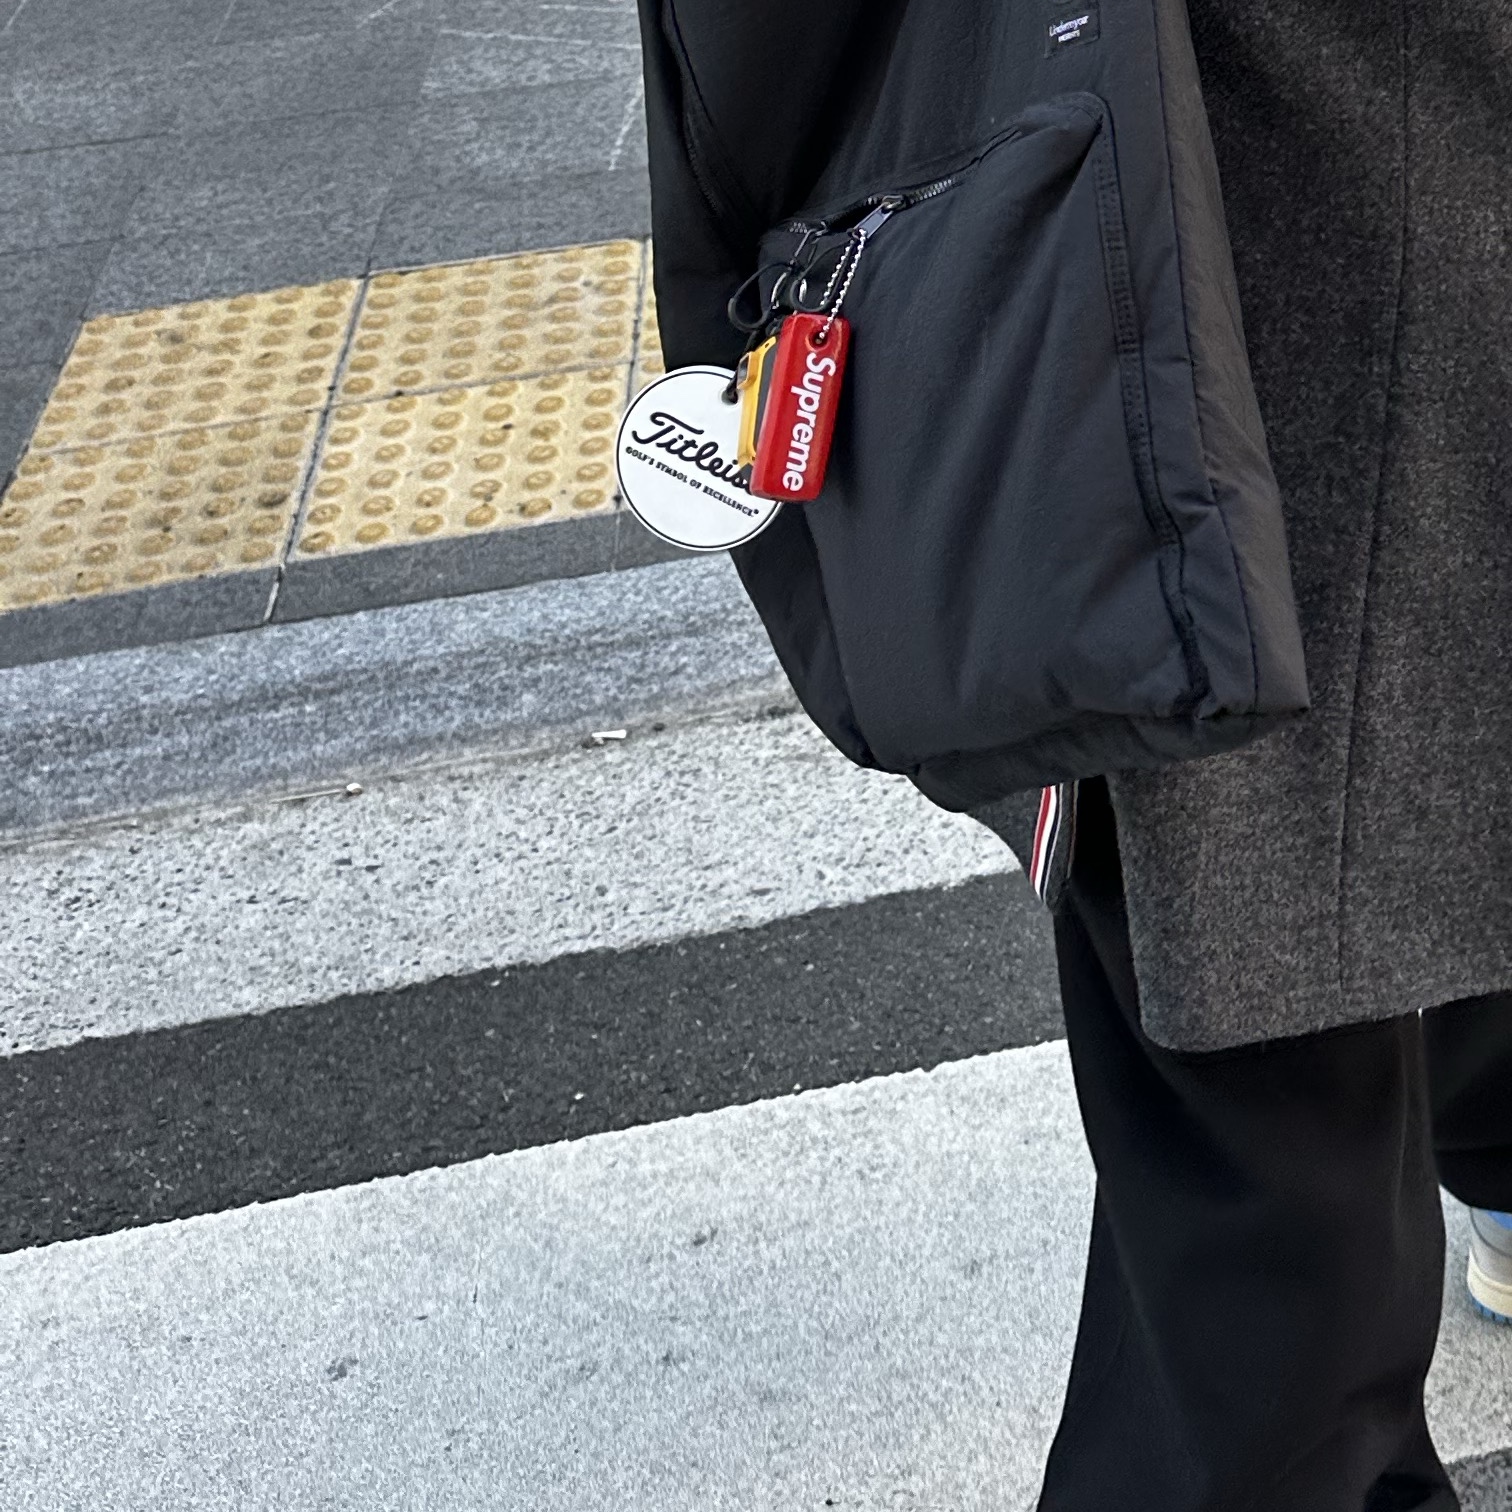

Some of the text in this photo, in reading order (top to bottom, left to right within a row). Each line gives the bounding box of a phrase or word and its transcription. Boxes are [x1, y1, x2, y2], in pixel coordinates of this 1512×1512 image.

[631, 411, 753, 495] Titleis
[782, 351, 837, 492] Supreme
[656, 461, 689, 484] SYMBOL
